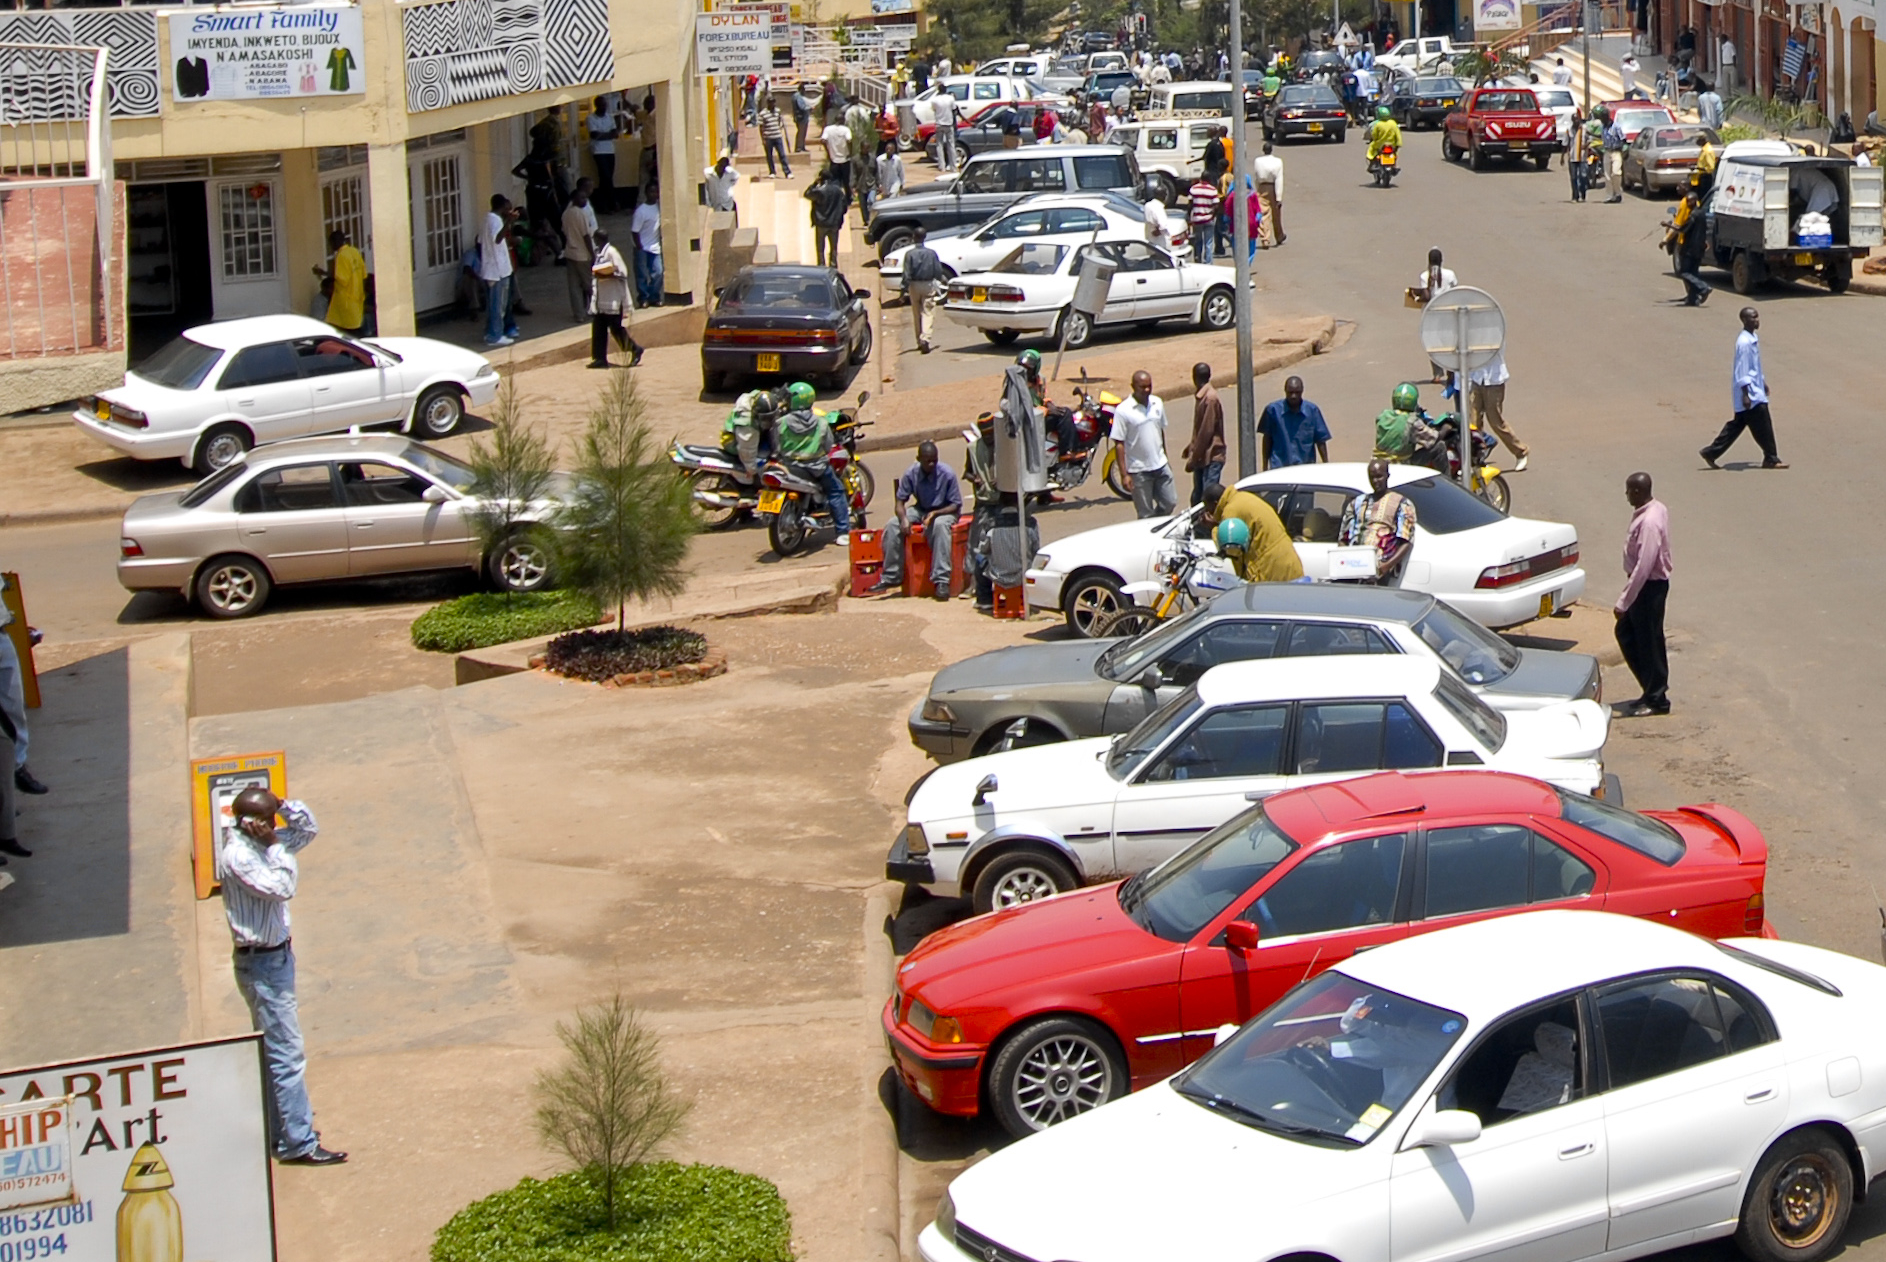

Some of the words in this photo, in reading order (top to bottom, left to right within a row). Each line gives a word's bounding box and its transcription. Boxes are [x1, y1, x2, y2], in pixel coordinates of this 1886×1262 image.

[192, 12, 264, 33] Smart
[270, 9, 338, 33] Family
[711, 14, 760, 26] DYLAN
[188, 37, 241, 50] IMYENDA,
[243, 35, 299, 48] INKWETO,
[302, 33, 340, 45] BIJOUX
[1505, 120, 1531, 128] ISUZU
[0, 1233, 68, 1262] 01994
